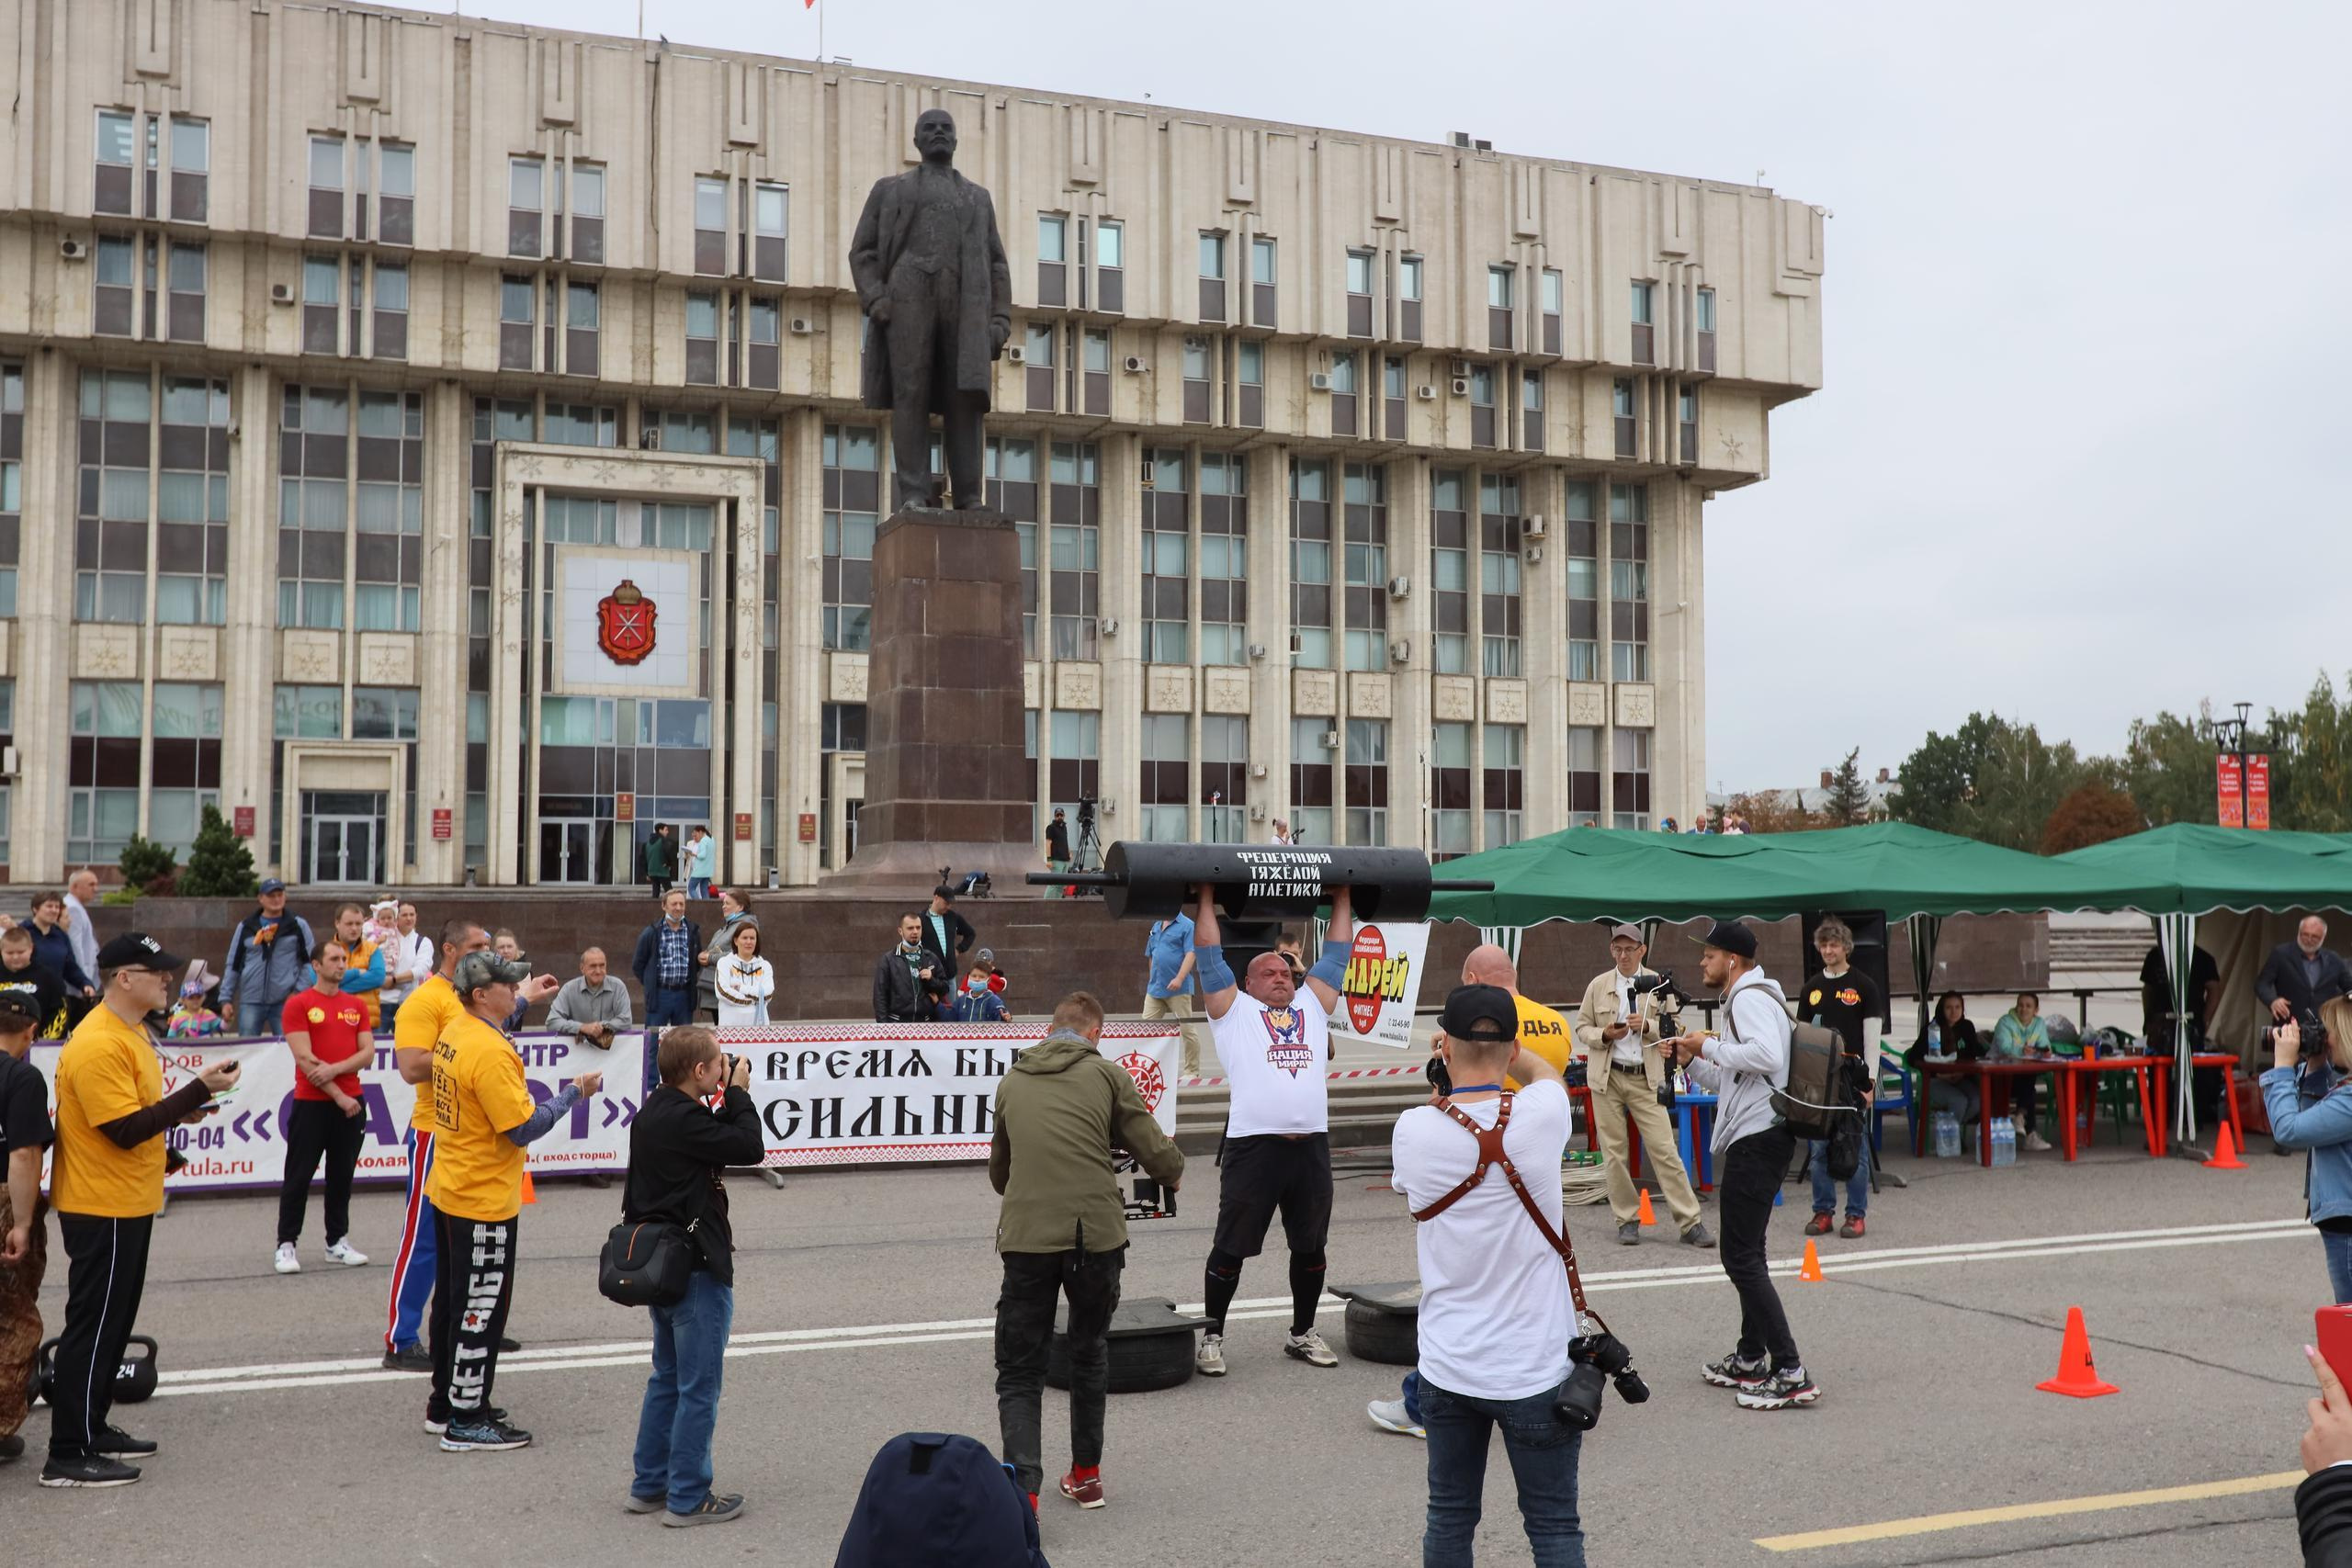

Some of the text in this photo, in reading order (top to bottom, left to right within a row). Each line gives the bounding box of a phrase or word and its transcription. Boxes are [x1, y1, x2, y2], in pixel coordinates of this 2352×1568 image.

[1237, 852, 1332, 863] ФЕДЕРАЦИЯ
[1250, 864, 1320, 880] ТЯЖЁЛОЙ
[1249, 883, 1322, 897] АТЛЕТИКИ
[1342, 950, 1409, 1003] НДРЕЙ
[1353, 1003, 1374, 1017] ФИТНЕС
[1521, 1020, 1563, 1037] ДЬЯ
[516, 1043, 570, 1067] НТР
[1268, 1050, 1313, 1061] НАЦИЯ
[1278, 1059, 1306, 1067] МИРА
[763, 1094, 995, 1141] СИЛЬН
[580, 1151, 617, 1163] торца)
[448, 1271, 504, 1410] GET BIG
[117, 1363, 135, 1380] 24
